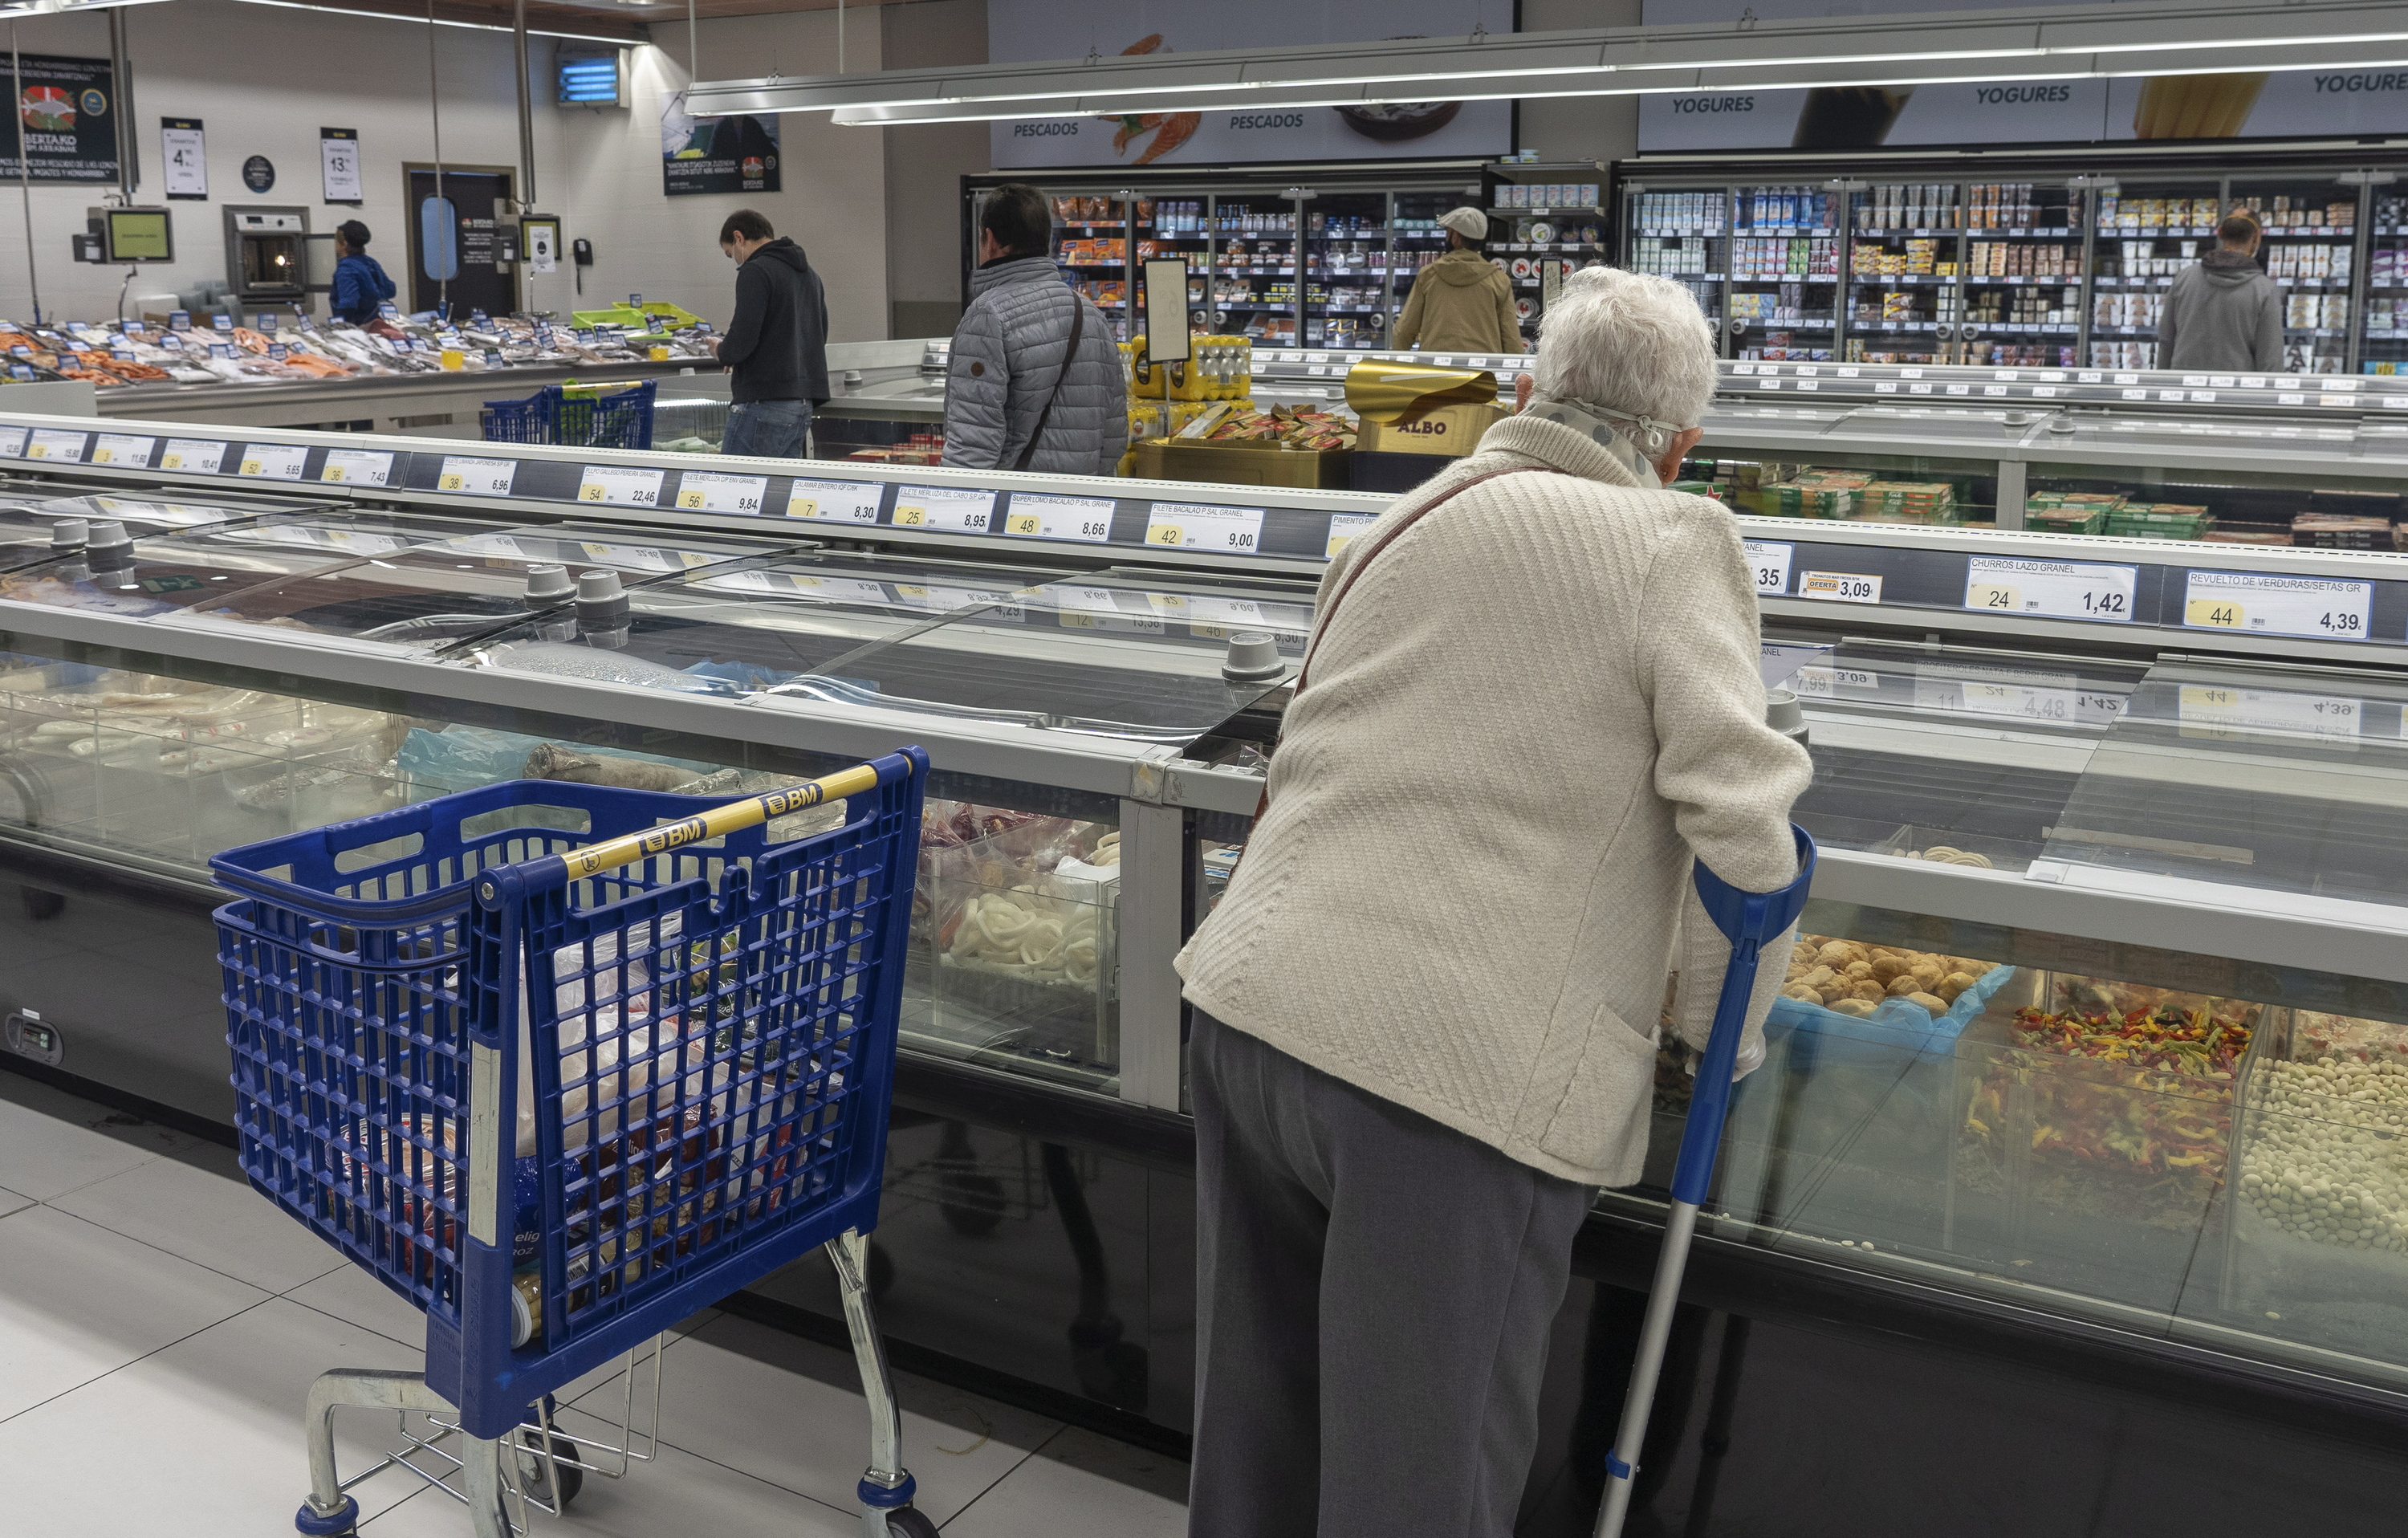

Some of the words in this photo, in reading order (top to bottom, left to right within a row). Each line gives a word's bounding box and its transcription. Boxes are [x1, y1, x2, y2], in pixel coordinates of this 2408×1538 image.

[1976, 85, 2071, 105] YOGURES
[1672, 96, 1755, 114] YOGURES
[1229, 114, 1304, 130] PESCADOS
[1014, 122, 1079, 137] PESCADOS
[173, 149, 184, 167] 4
[331, 157, 345, 173] 13
[1397, 421, 1447, 435] ALBO
[248, 463, 258, 474] 52
[286, 465, 300, 476] 5,65
[585, 467, 600, 475] PULPO
[620, 470, 639, 478] PEREIRA
[331, 470, 340, 482] 36
[370, 471, 385, 482] 7,43
[684, 473, 699, 481] FILETE
[699, 474, 721, 482] MERLUZA
[449, 478, 459, 490] 38
[492, 479, 508, 491] 6,96
[794, 480, 817, 490] CALAMAR
[817, 482, 837, 491] ENTERO
[589, 489, 600, 501] 54
[633, 490, 655, 503] 22,46
[900, 487, 918, 497] FILETE
[918, 489, 942, 498] MERLUZA
[942, 490, 953, 499] DEL
[953, 491, 969, 501] CABO
[978, 493, 986, 501] GR
[688, 496, 701, 508] 56
[738, 498, 758, 511] 9,84
[1012, 494, 1032, 503] SUPER
[1032, 495, 1049, 504] LOMO
[1049, 497, 1075, 507] BACALAO
[1092, 500, 1112, 509] GRANE
[807, 504, 813, 517] 7
[854, 507, 874, 520] 8,30
[1153, 504, 1173, 514] FILETE
[1173, 506, 1201, 515] BACALAO
[1219, 509, 1244, 518] GRANEL
[906, 511, 920, 525] 25
[1333, 516, 1364, 526] PIMIENTO
[1020, 519, 1035, 533] 48
[1161, 530, 1177, 544] 42
[1971, 559, 2014, 570] CHURROS
[2015, 561, 2039, 572] LAZO
[2040, 563, 2076, 575] GRANEL
[1809, 580, 1837, 589] OFERTA
[2190, 573, 2240, 586] REVUELTO
[2242, 576, 2255, 587] DE
[2257, 578, 2345, 592] VERDURAS/SETAS
[2345, 584, 2361, 593] GR
[1988, 590, 2009, 608] 24
[1076, 614, 1088, 627] 12
[2210, 608, 2233, 625] 44
[1206, 625, 1221, 638] 46
[1918, 661, 1980, 675] PROFITEROLES
[1983, 666, 2003, 677] NATA
[2041, 673, 2066, 682] GRAN
[1938, 694, 1954, 711] 11
[788, 785, 817, 809] BM
[669, 820, 700, 847] BM
